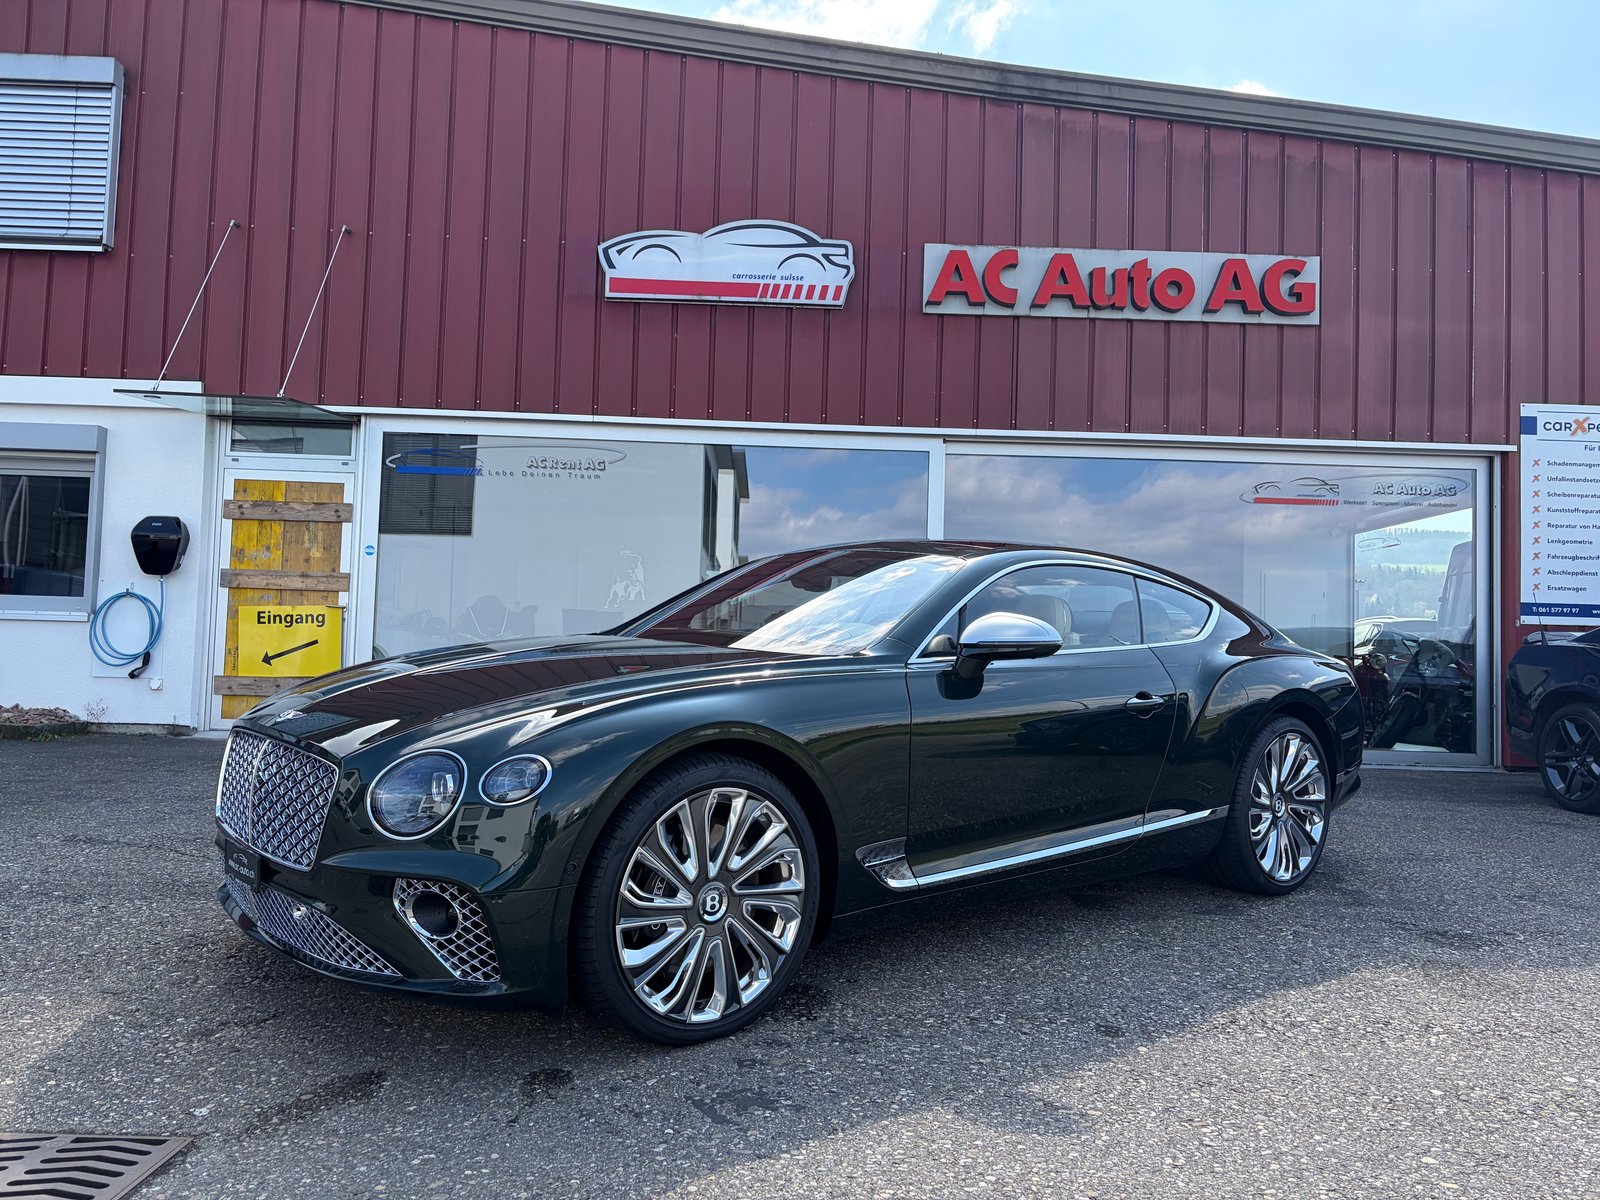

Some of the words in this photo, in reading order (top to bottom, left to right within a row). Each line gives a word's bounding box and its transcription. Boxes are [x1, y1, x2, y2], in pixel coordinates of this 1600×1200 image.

[732, 273, 777, 281] carrosserie
[780, 274, 805, 282] suisse
[926, 248, 1019, 307] AC
[1030, 252, 1196, 313] Auto
[1202, 258, 1316, 316] AG
[527, 456, 547, 469] AC
[549, 457, 582, 471] Rent
[583, 458, 606, 472] AG
[568, 472, 601, 480] Traum
[1373, 482, 1394, 495] AC
[1397, 483, 1431, 496] Auto
[1432, 484, 1457, 497] AG
[1547, 522, 1577, 531] Reparatur
[1547, 538, 1593, 546] Lenkgeometrie
[1547, 569, 1599, 578] Abschleppdienst
[1547, 584, 1587, 593] Ersatzwagen
[256, 610, 326, 628] Eingang
